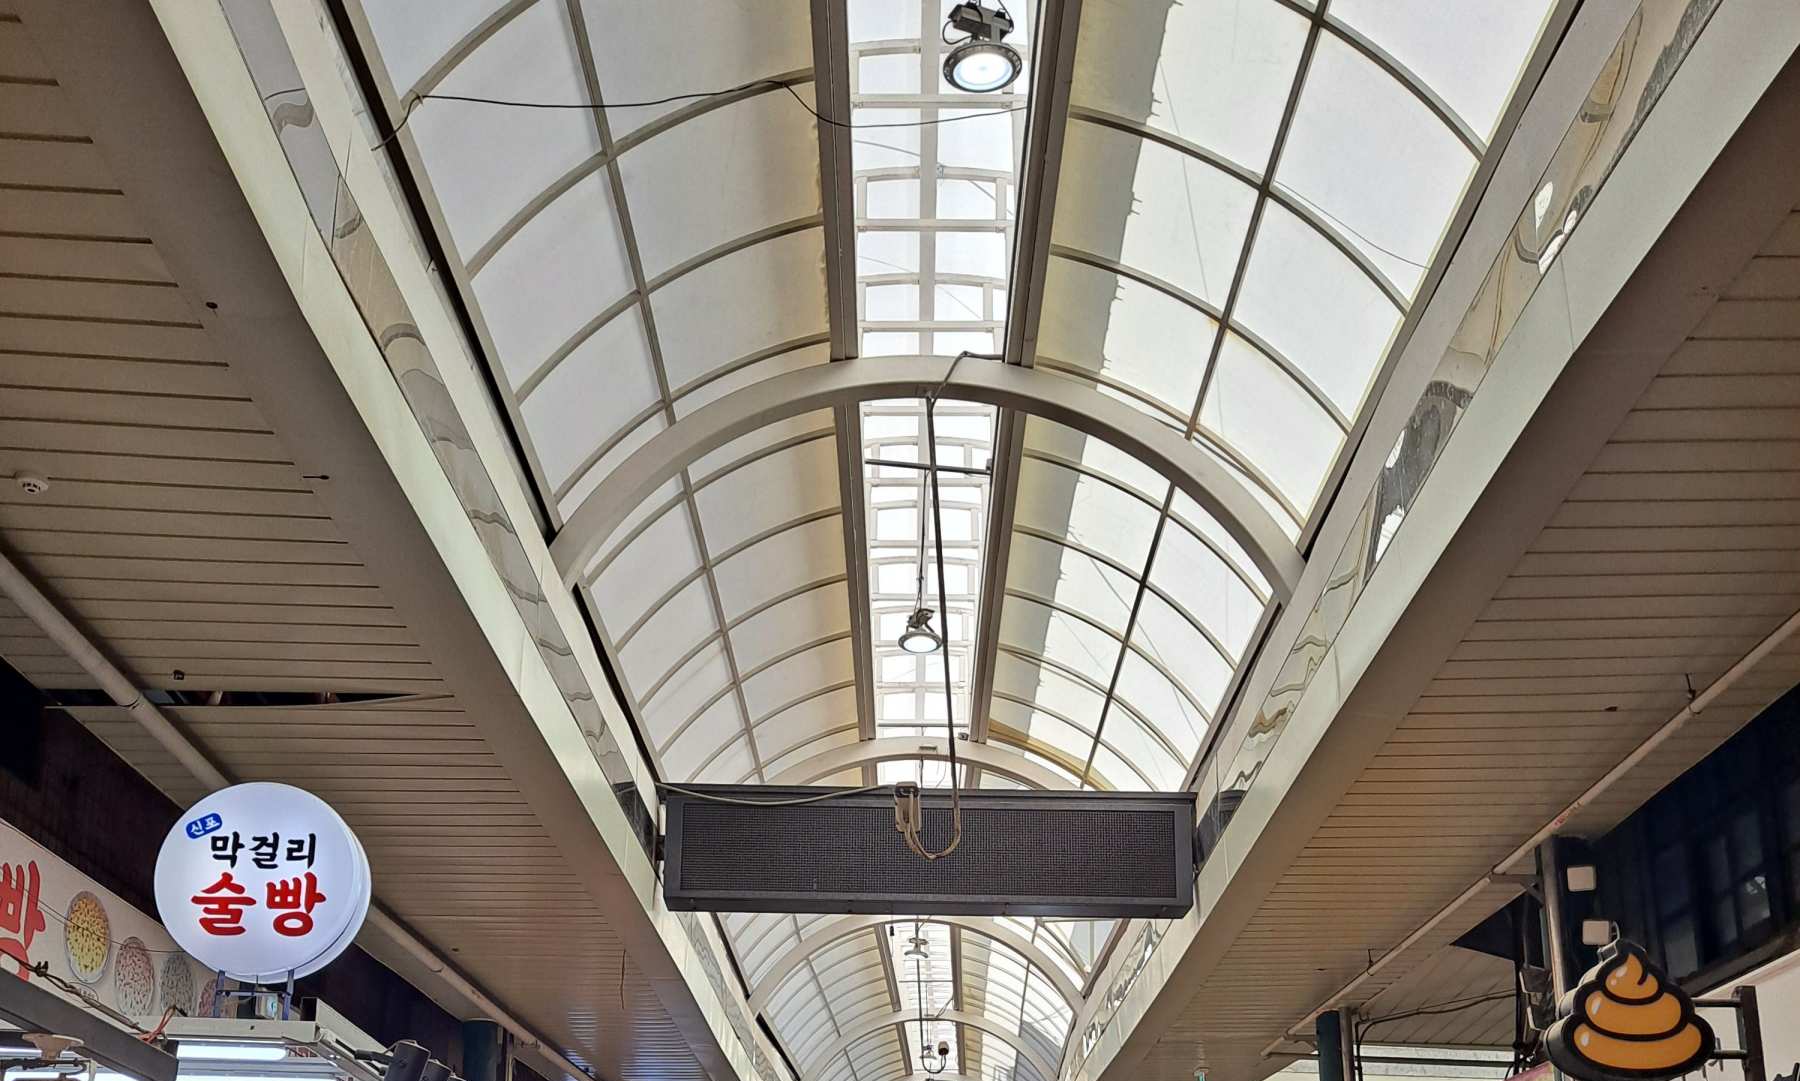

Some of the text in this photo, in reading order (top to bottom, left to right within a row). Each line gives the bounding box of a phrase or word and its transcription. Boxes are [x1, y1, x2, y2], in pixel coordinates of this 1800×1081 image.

[190, 817, 219, 834] 신포
[210, 831, 317, 869] 막걸리
[191, 872, 327, 937] 술빵
